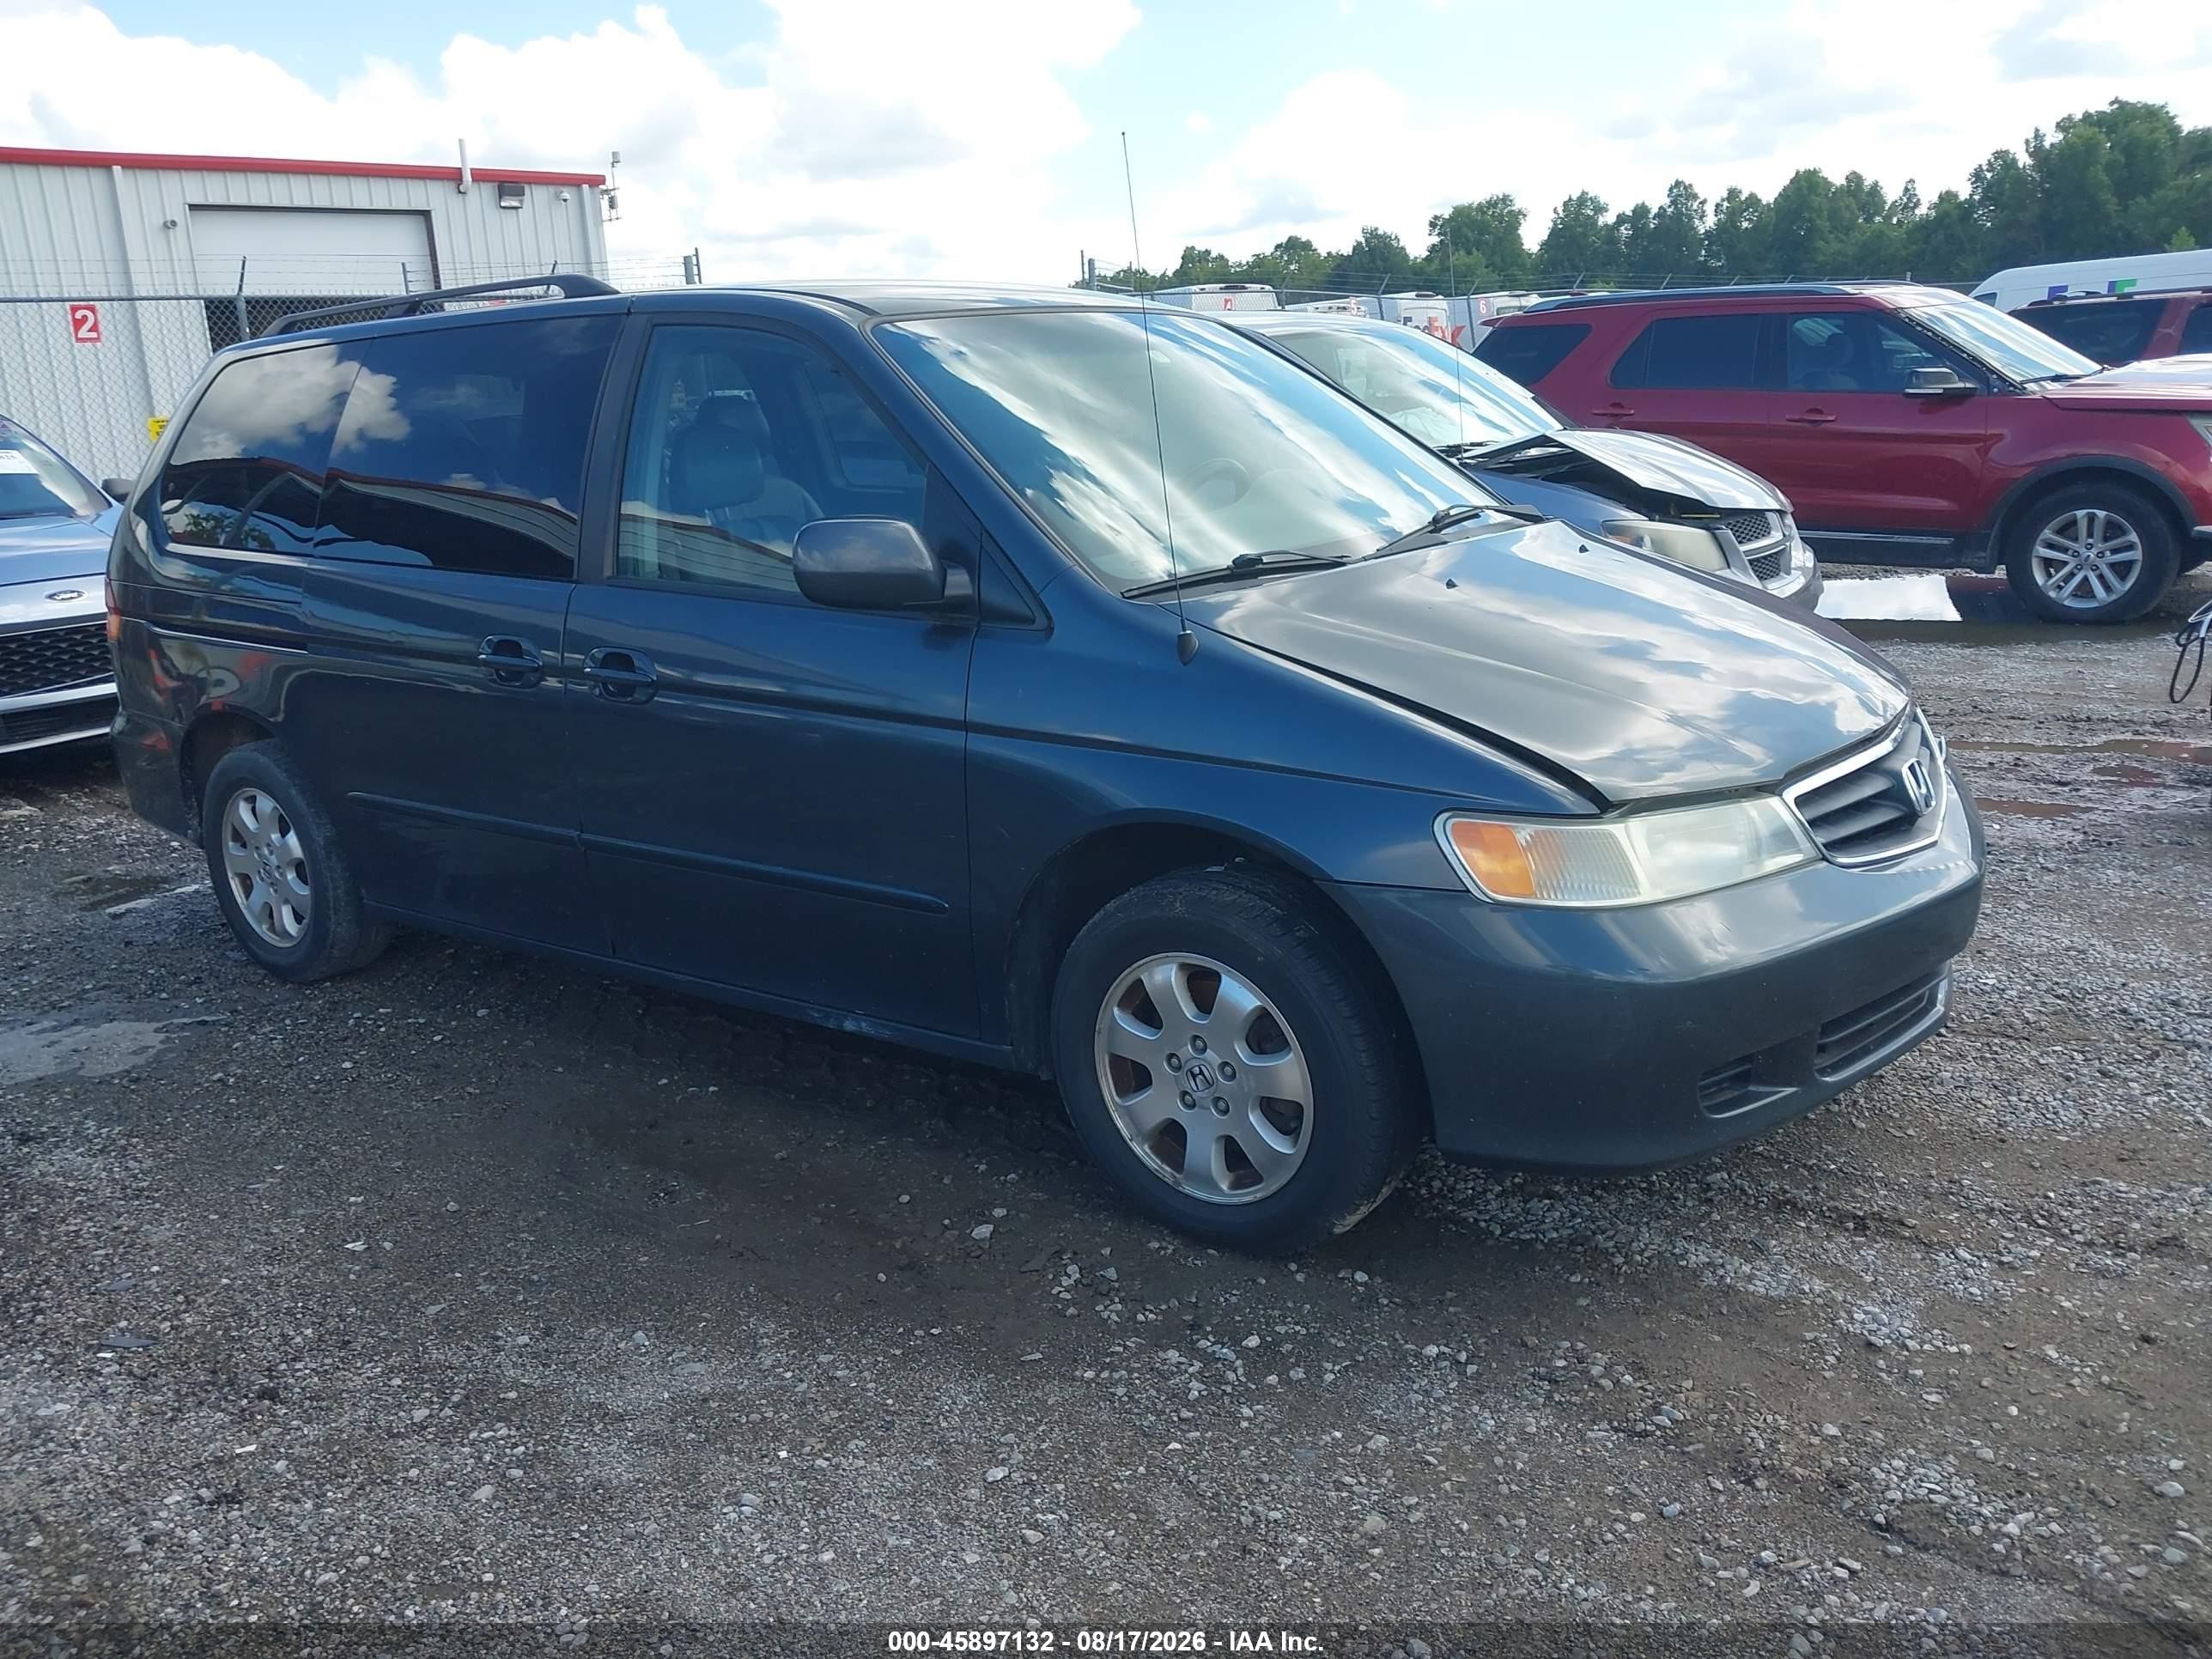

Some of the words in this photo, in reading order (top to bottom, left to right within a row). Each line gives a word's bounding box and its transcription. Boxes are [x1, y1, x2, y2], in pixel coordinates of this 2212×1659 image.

[1351, 299, 1358, 315] 5
[1480, 300, 1486, 313] 6
[74, 309, 99, 338] 2
